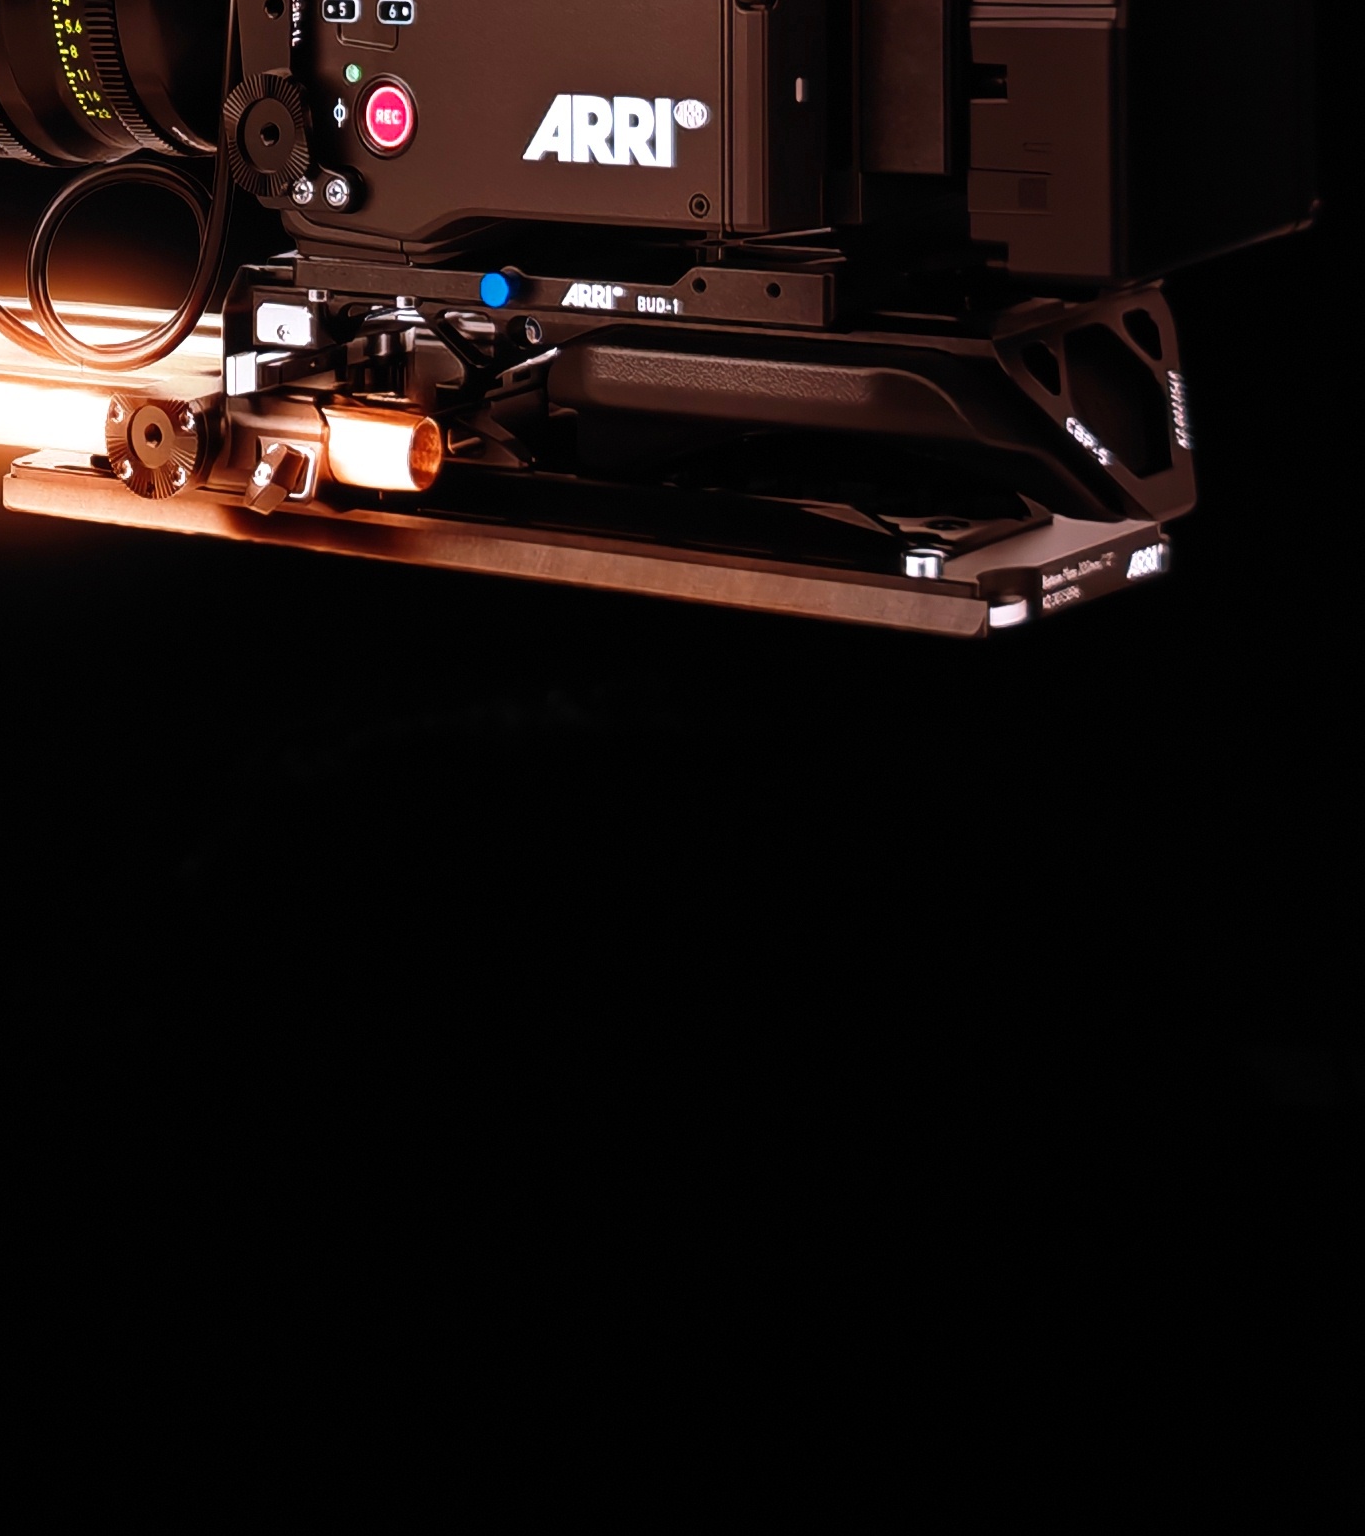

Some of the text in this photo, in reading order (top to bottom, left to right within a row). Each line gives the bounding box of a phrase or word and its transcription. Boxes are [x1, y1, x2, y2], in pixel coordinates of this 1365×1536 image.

[338, 2, 397, 19] 5 6
[64, 18, 82, 34] 5.6
[69, 44, 79, 58] 8
[77, 69, 91, 82] 11
[374, 109, 402, 125] REC
[523, 94, 673, 168] ARRI
[561, 282, 680, 315] ARRI BUD-1
